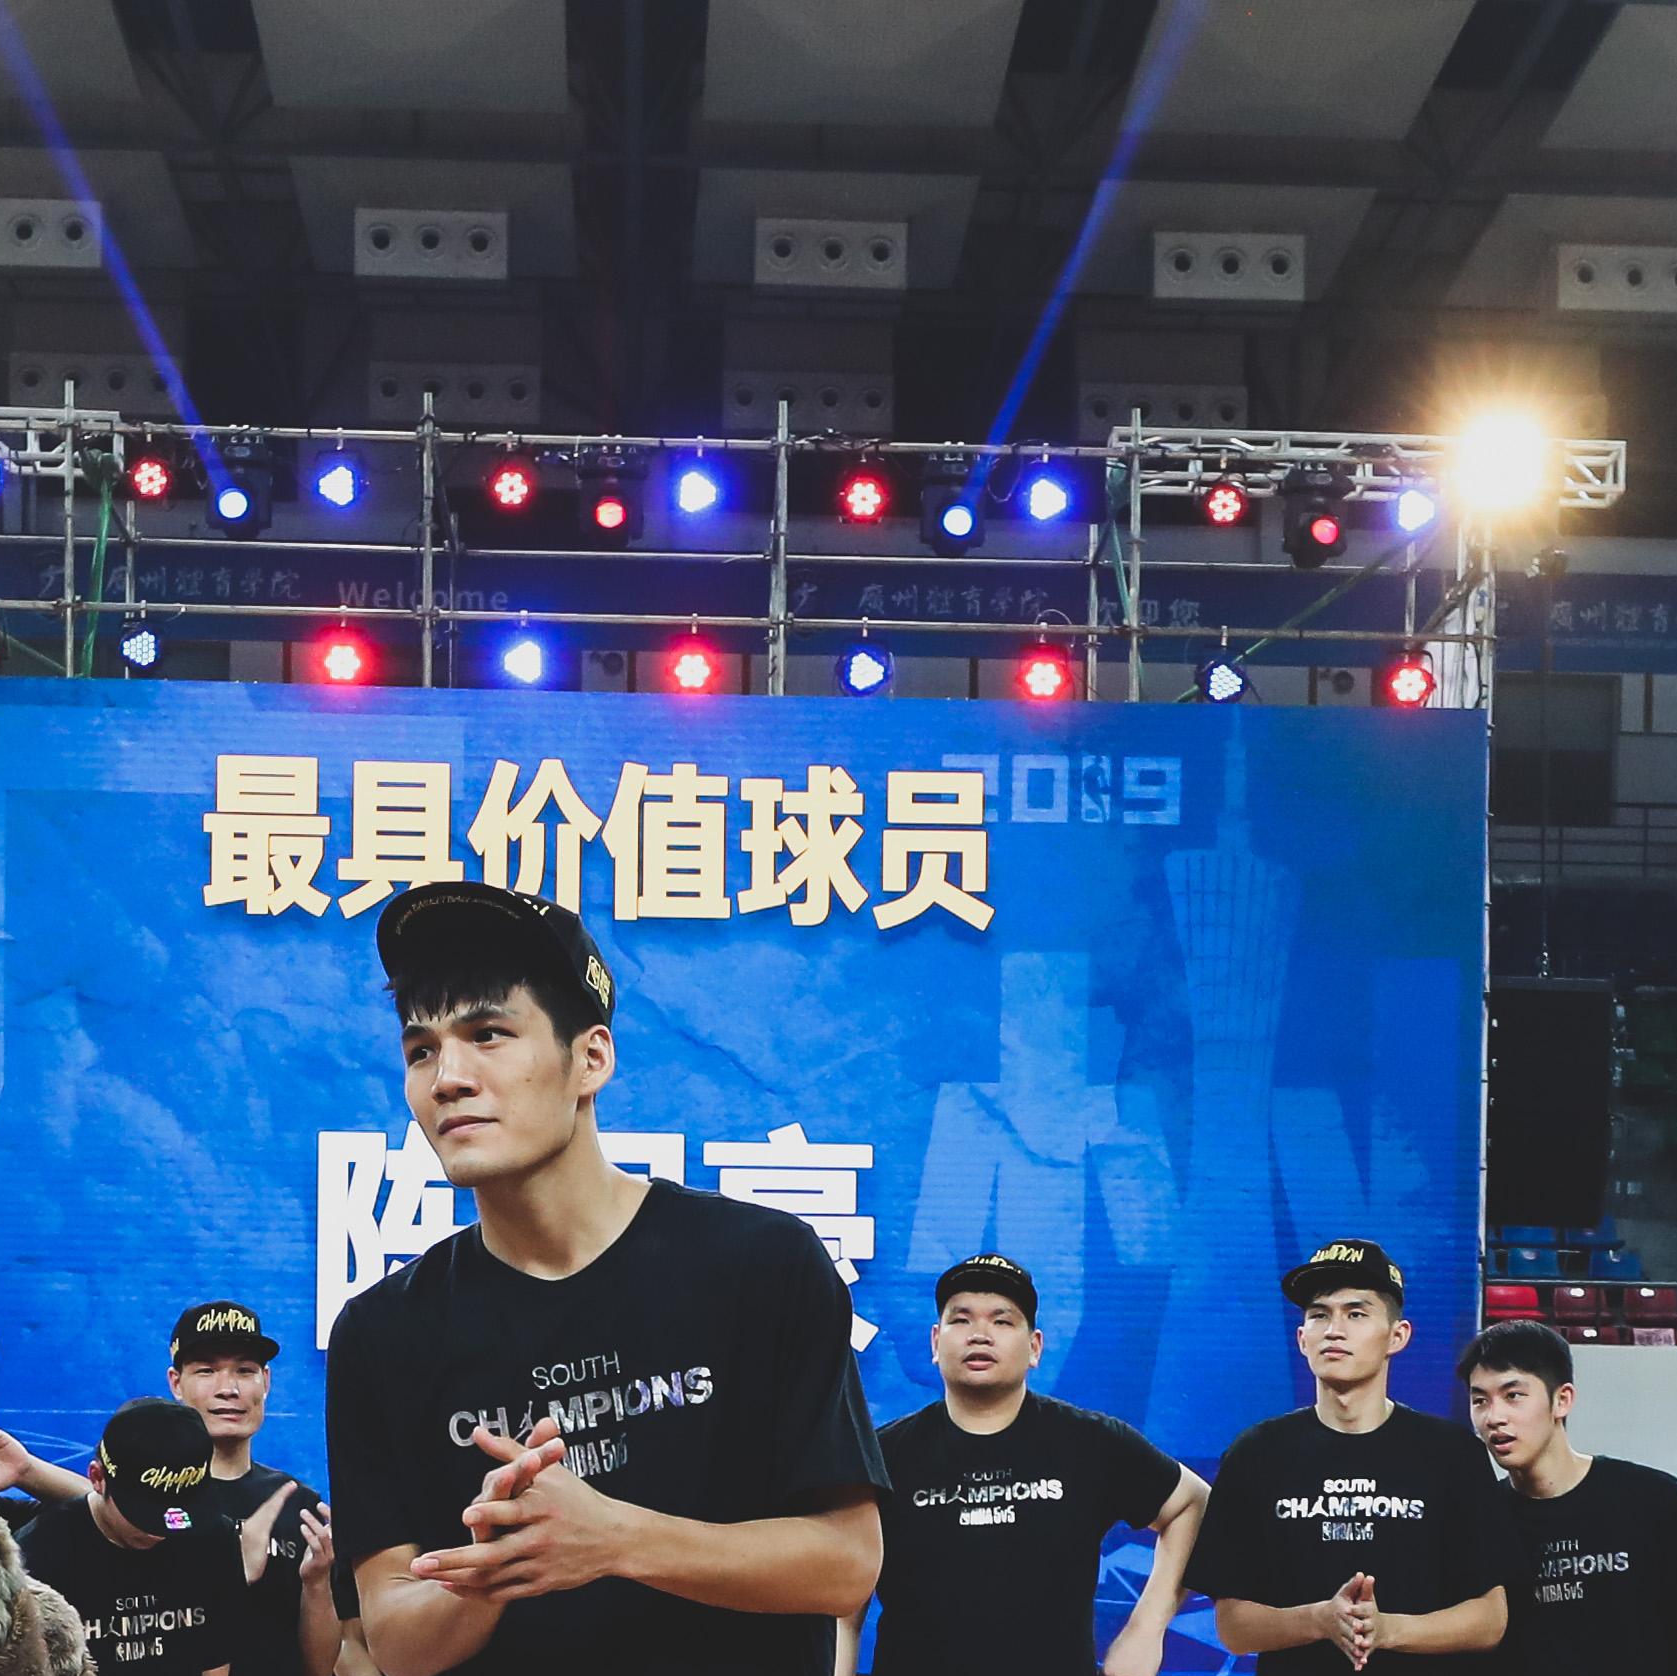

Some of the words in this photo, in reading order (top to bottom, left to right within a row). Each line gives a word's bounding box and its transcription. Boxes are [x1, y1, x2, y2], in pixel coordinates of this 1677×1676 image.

[201, 753, 997, 932] 最具价值球员
[196, 1308, 256, 1333] CHAMPION
[531, 1350, 622, 1391] SOUTH
[600, 1432, 629, 1473] 5v5
[140, 1460, 208, 1494] CHAMPION
[963, 1467, 1013, 1483] SOUTH
[1323, 1478, 1376, 1494] SOUTH
[912, 1478, 1064, 1508] CHAMPIONS
[993, 1505, 1016, 1524] 5v5
[1275, 1495, 1425, 1520] CHAMPIONS
[1332, 1522, 1354, 1541] NBA
[1353, 1521, 1374, 1541] 5v5
[1542, 1583, 1564, 1603] NBA
[1563, 1581, 1584, 1600] 5v5
[85, 1607, 206, 1640] HAMPIONS
